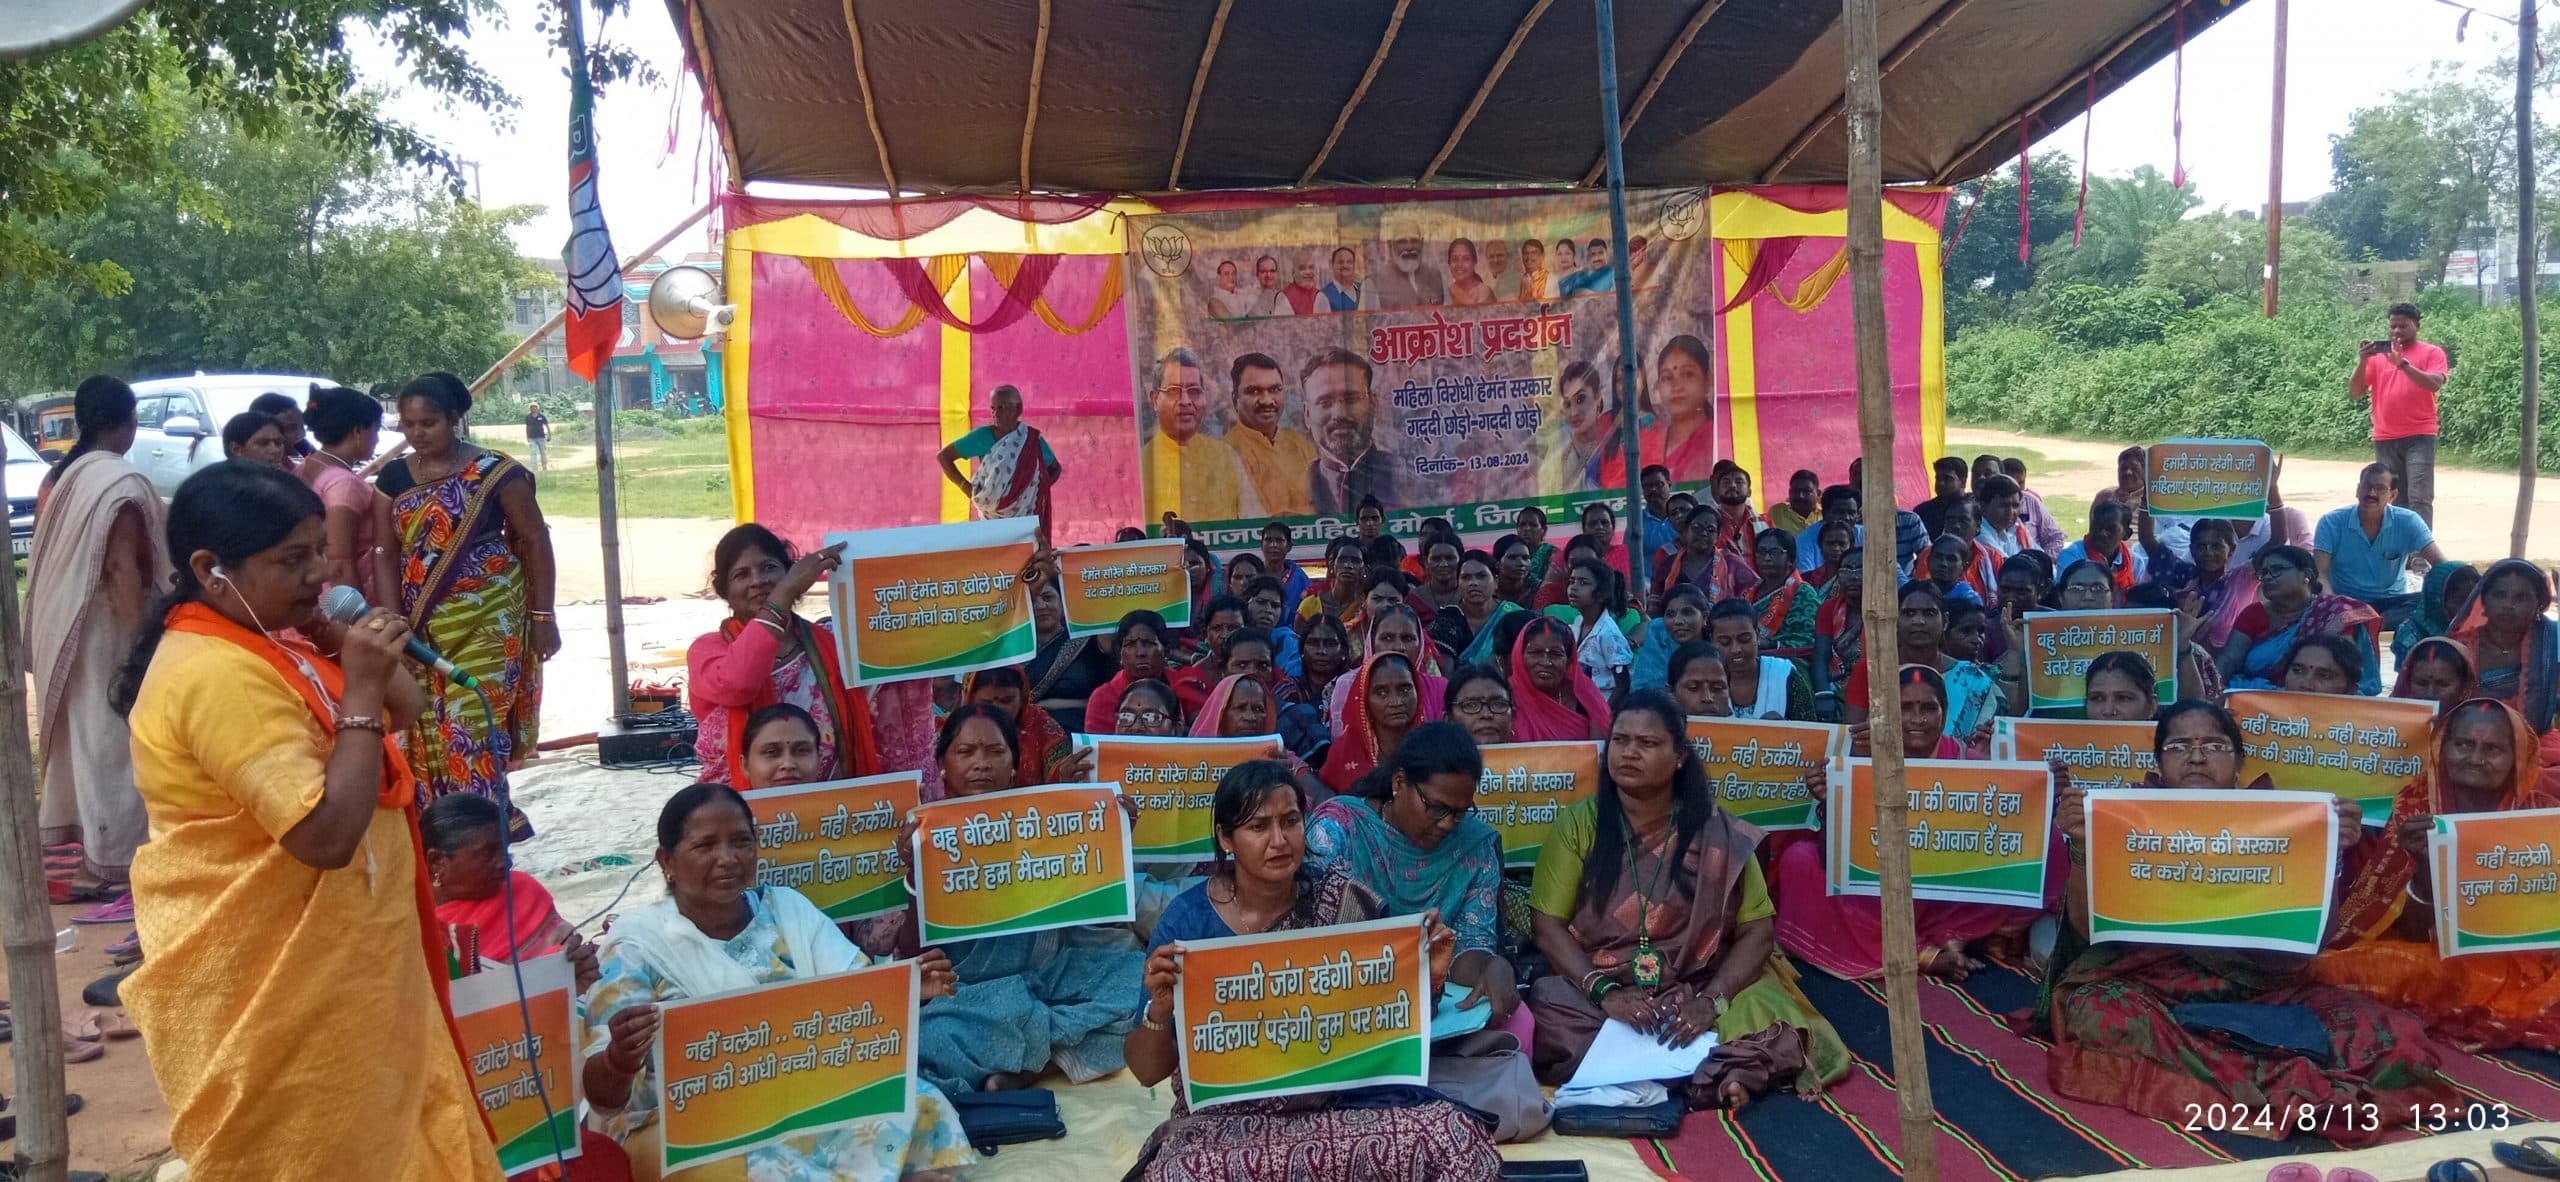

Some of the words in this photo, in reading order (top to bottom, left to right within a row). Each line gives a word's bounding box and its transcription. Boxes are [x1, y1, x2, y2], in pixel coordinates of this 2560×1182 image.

[1370, 312, 1474, 366] आक्रोश
[1481, 304, 1573, 361] प्रदर्शन
[1394, 380, 1433, 407] महिला
[1437, 376, 1474, 405] विरोधी
[1477, 375, 1507, 401] हेमंत
[1510, 377, 1552, 396] सरकार
[1470, 453, 1529, 470] 13.08.2024
[2163, 453, 2188, 471] हमारी
[2190, 454, 2207, 470] जंग
[2210, 454, 2233, 472] रहेगी
[2235, 453, 2256, 472] जारी
[2213, 480, 2227, 501] तुम
[2230, 481, 2242, 495] पर
[2242, 479, 2263, 496] भारी
[1126, 563, 1137, 576] की
[1139, 564, 1167, 575] सरकार
[873, 579, 907, 612] जुल्मी
[911, 577, 939, 600] हेमंत
[942, 580, 958, 595] का
[962, 572, 990, 595] खोले
[868, 610, 907, 630] महिला
[911, 604, 937, 626] मोर्चा
[942, 608, 957, 623] का
[960, 605, 990, 623] हल्ला
[2099, 624, 2116, 645] की
[2120, 629, 2146, 645] शान
[2150, 623, 2164, 644] में
[2043, 654, 2069, 677] उतरे
[2241, 713, 2270, 734] नहीं
[2270, 716, 2308, 738] चलेगी
[2110, 744, 2131, 768] तेरी
[2261, 741, 2279, 761] की
[2352, 753, 2380, 774] नहीं
[2382, 755, 2422, 776] सहेगी
[1125, 763, 1153, 784] हेमंत
[1158, 762, 1188, 783] सोरेन
[1192, 760, 1208, 781] की
[1507, 766, 1527, 793] तेरी
[1531, 772, 1574, 792] सरकार
[1723, 772, 1754, 800] हिला
[1757, 782, 1781, 799] कर
[1176, 790, 1185, 809] ये
[1924, 781, 1944, 812] की
[1948, 790, 1979, 813] नाज
[1998, 792, 2022, 816] हम
[931, 826, 961, 863] बहु
[962, 810, 1013, 847] बेटियों
[1015, 807, 1041, 840] की
[1047, 811, 1084, 838] शान
[1087, 801, 1107, 833] में
[1909, 820, 1929, 850] की
[1932, 829, 1979, 851] आवाज
[1999, 832, 2023, 856] हम
[2126, 828, 2162, 852] हेमंत
[2167, 830, 2206, 854] सोरेन
[2210, 829, 2233, 854] की
[2237, 837, 2290, 854] सरकार
[818, 848, 852, 885] हिला
[855, 851, 879, 877] कर
[942, 859, 980, 894] उतरे
[984, 862, 1012, 890] हम
[1016, 849, 1066, 882] मैदान
[1071, 844, 1090, 875] में
[2476, 845, 2506, 869] नहीं
[2509, 843, 2551, 868] चलेगी
[2130, 859, 2152, 879] बंद
[2157, 860, 2189, 880] करों
[2191, 862, 2204, 881] ये
[2208, 867, 2272, 884] अत्याचार
[2459, 879, 2495, 905] जुल्म
[2499, 873, 2519, 894] की
[2522, 872, 2557, 894] आंधी
[1214, 960, 1265, 1004] हमारी
[1268, 959, 1306, 998] जंग
[1308, 950, 1354, 996] रहेगी
[1356, 944, 1396, 986] जारी
[1192, 1010, 1264, 1054] महिलाएं
[1316, 1011, 1346, 1055] तुम
[1349, 1006, 1373, 1034] पर
[1375, 989, 1411, 1031] भारी
[685, 1030, 721, 1062] नहीं
[722, 1020, 772, 1054] चलेगी
[473, 1039, 511, 1075] खोले
[667, 1074, 708, 1113] जुल्म
[712, 1062, 735, 1091] की
[738, 1053, 778, 1087] आंधी
[821, 1037, 855, 1068] नहीं
[855, 1028, 902, 1063] सहेगी
